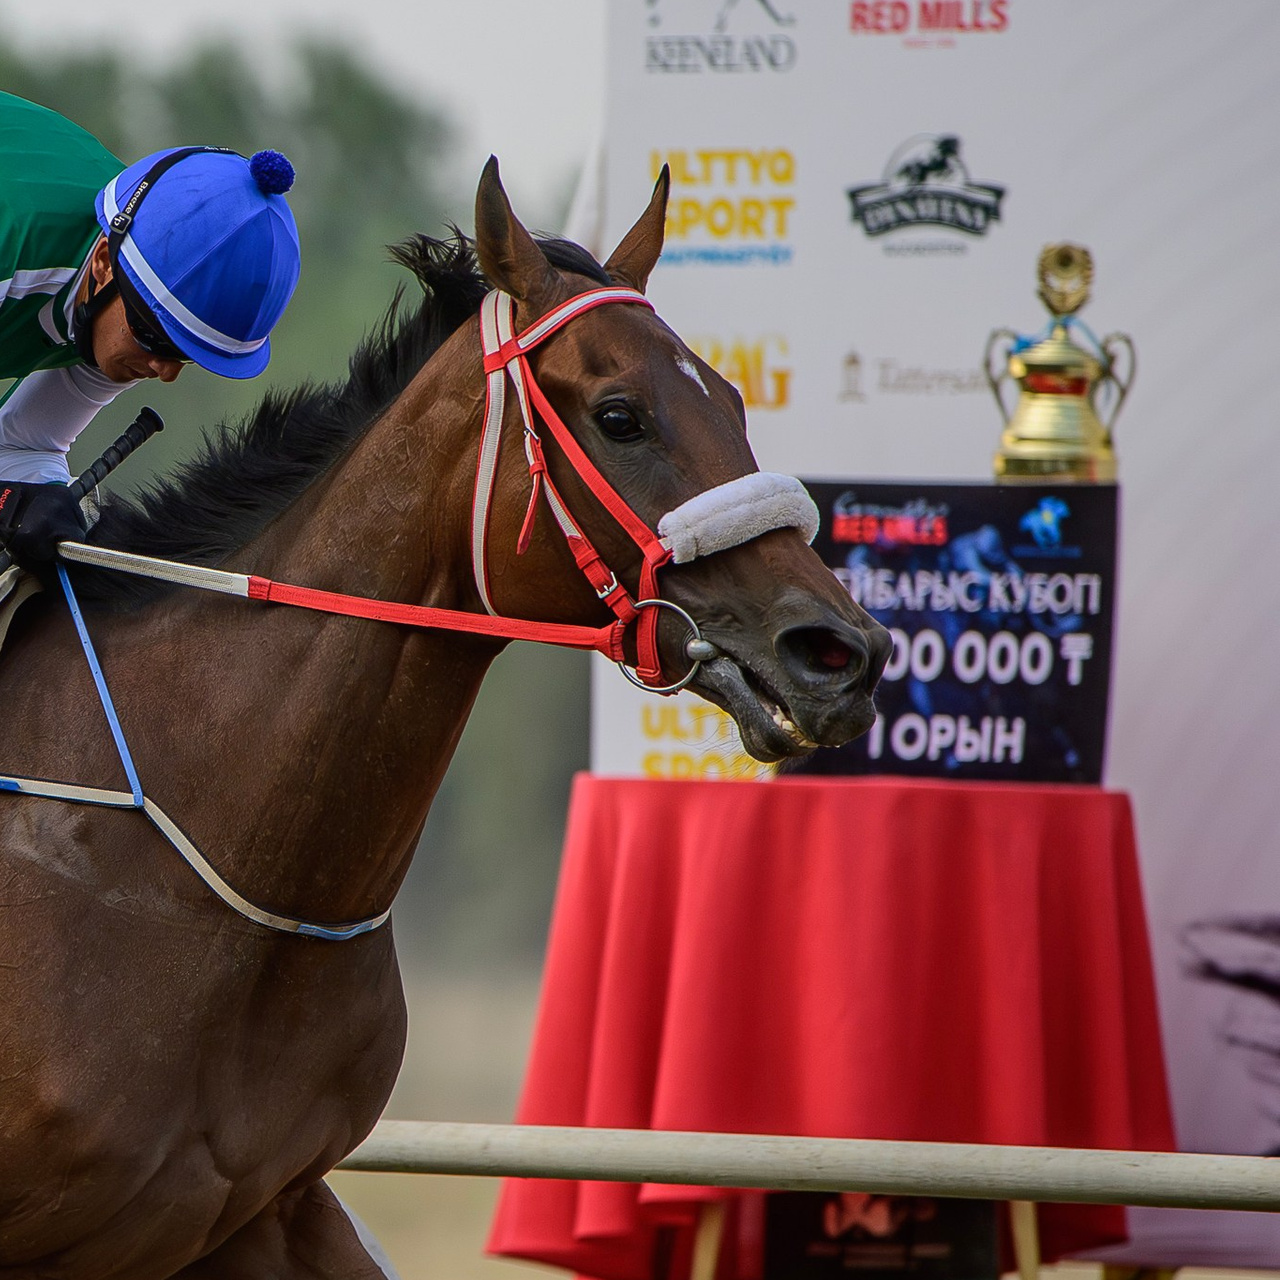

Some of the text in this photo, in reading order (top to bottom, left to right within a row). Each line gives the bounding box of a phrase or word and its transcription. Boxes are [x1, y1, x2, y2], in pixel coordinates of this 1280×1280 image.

[850, 0, 910, 35] RED
[125, 181, 149, 214] Breeze
[953, 629, 1054, 686] 000
[890, 712, 1027, 764] ОРЫН
